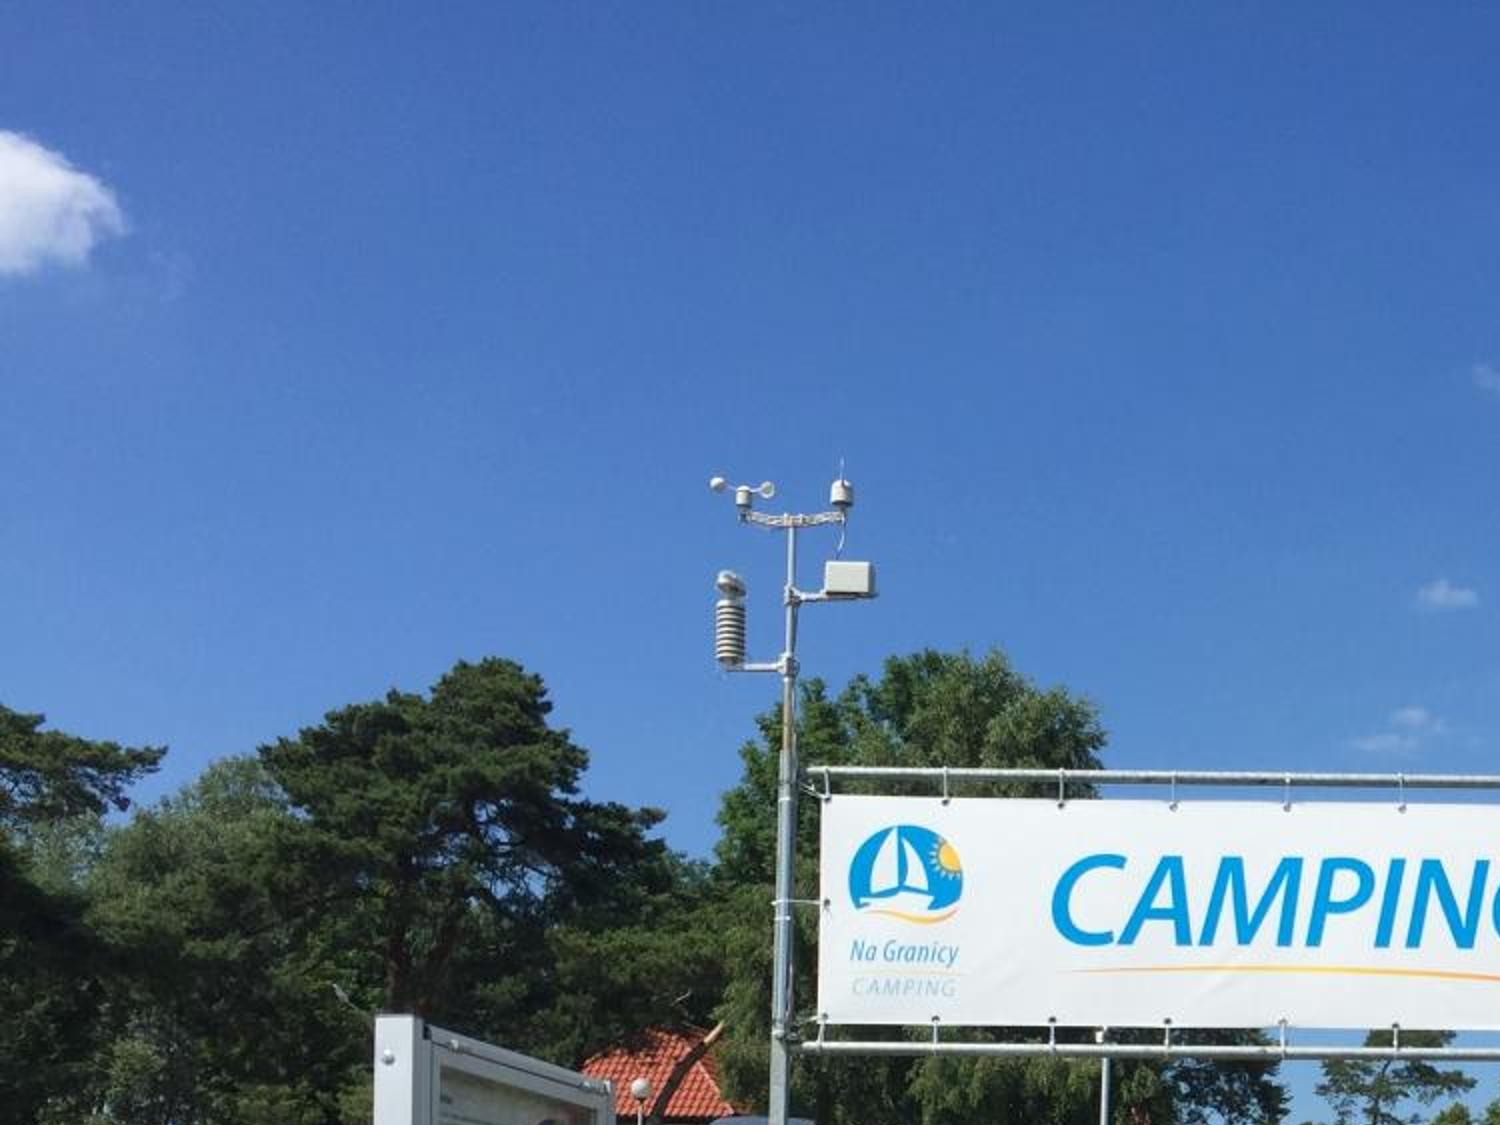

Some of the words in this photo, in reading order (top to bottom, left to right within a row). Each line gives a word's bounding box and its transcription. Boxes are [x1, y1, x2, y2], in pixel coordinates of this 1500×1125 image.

[849, 939, 878, 961] Na
[883, 939, 960, 969] Granicy
[851, 977, 957, 997] CAMPING
